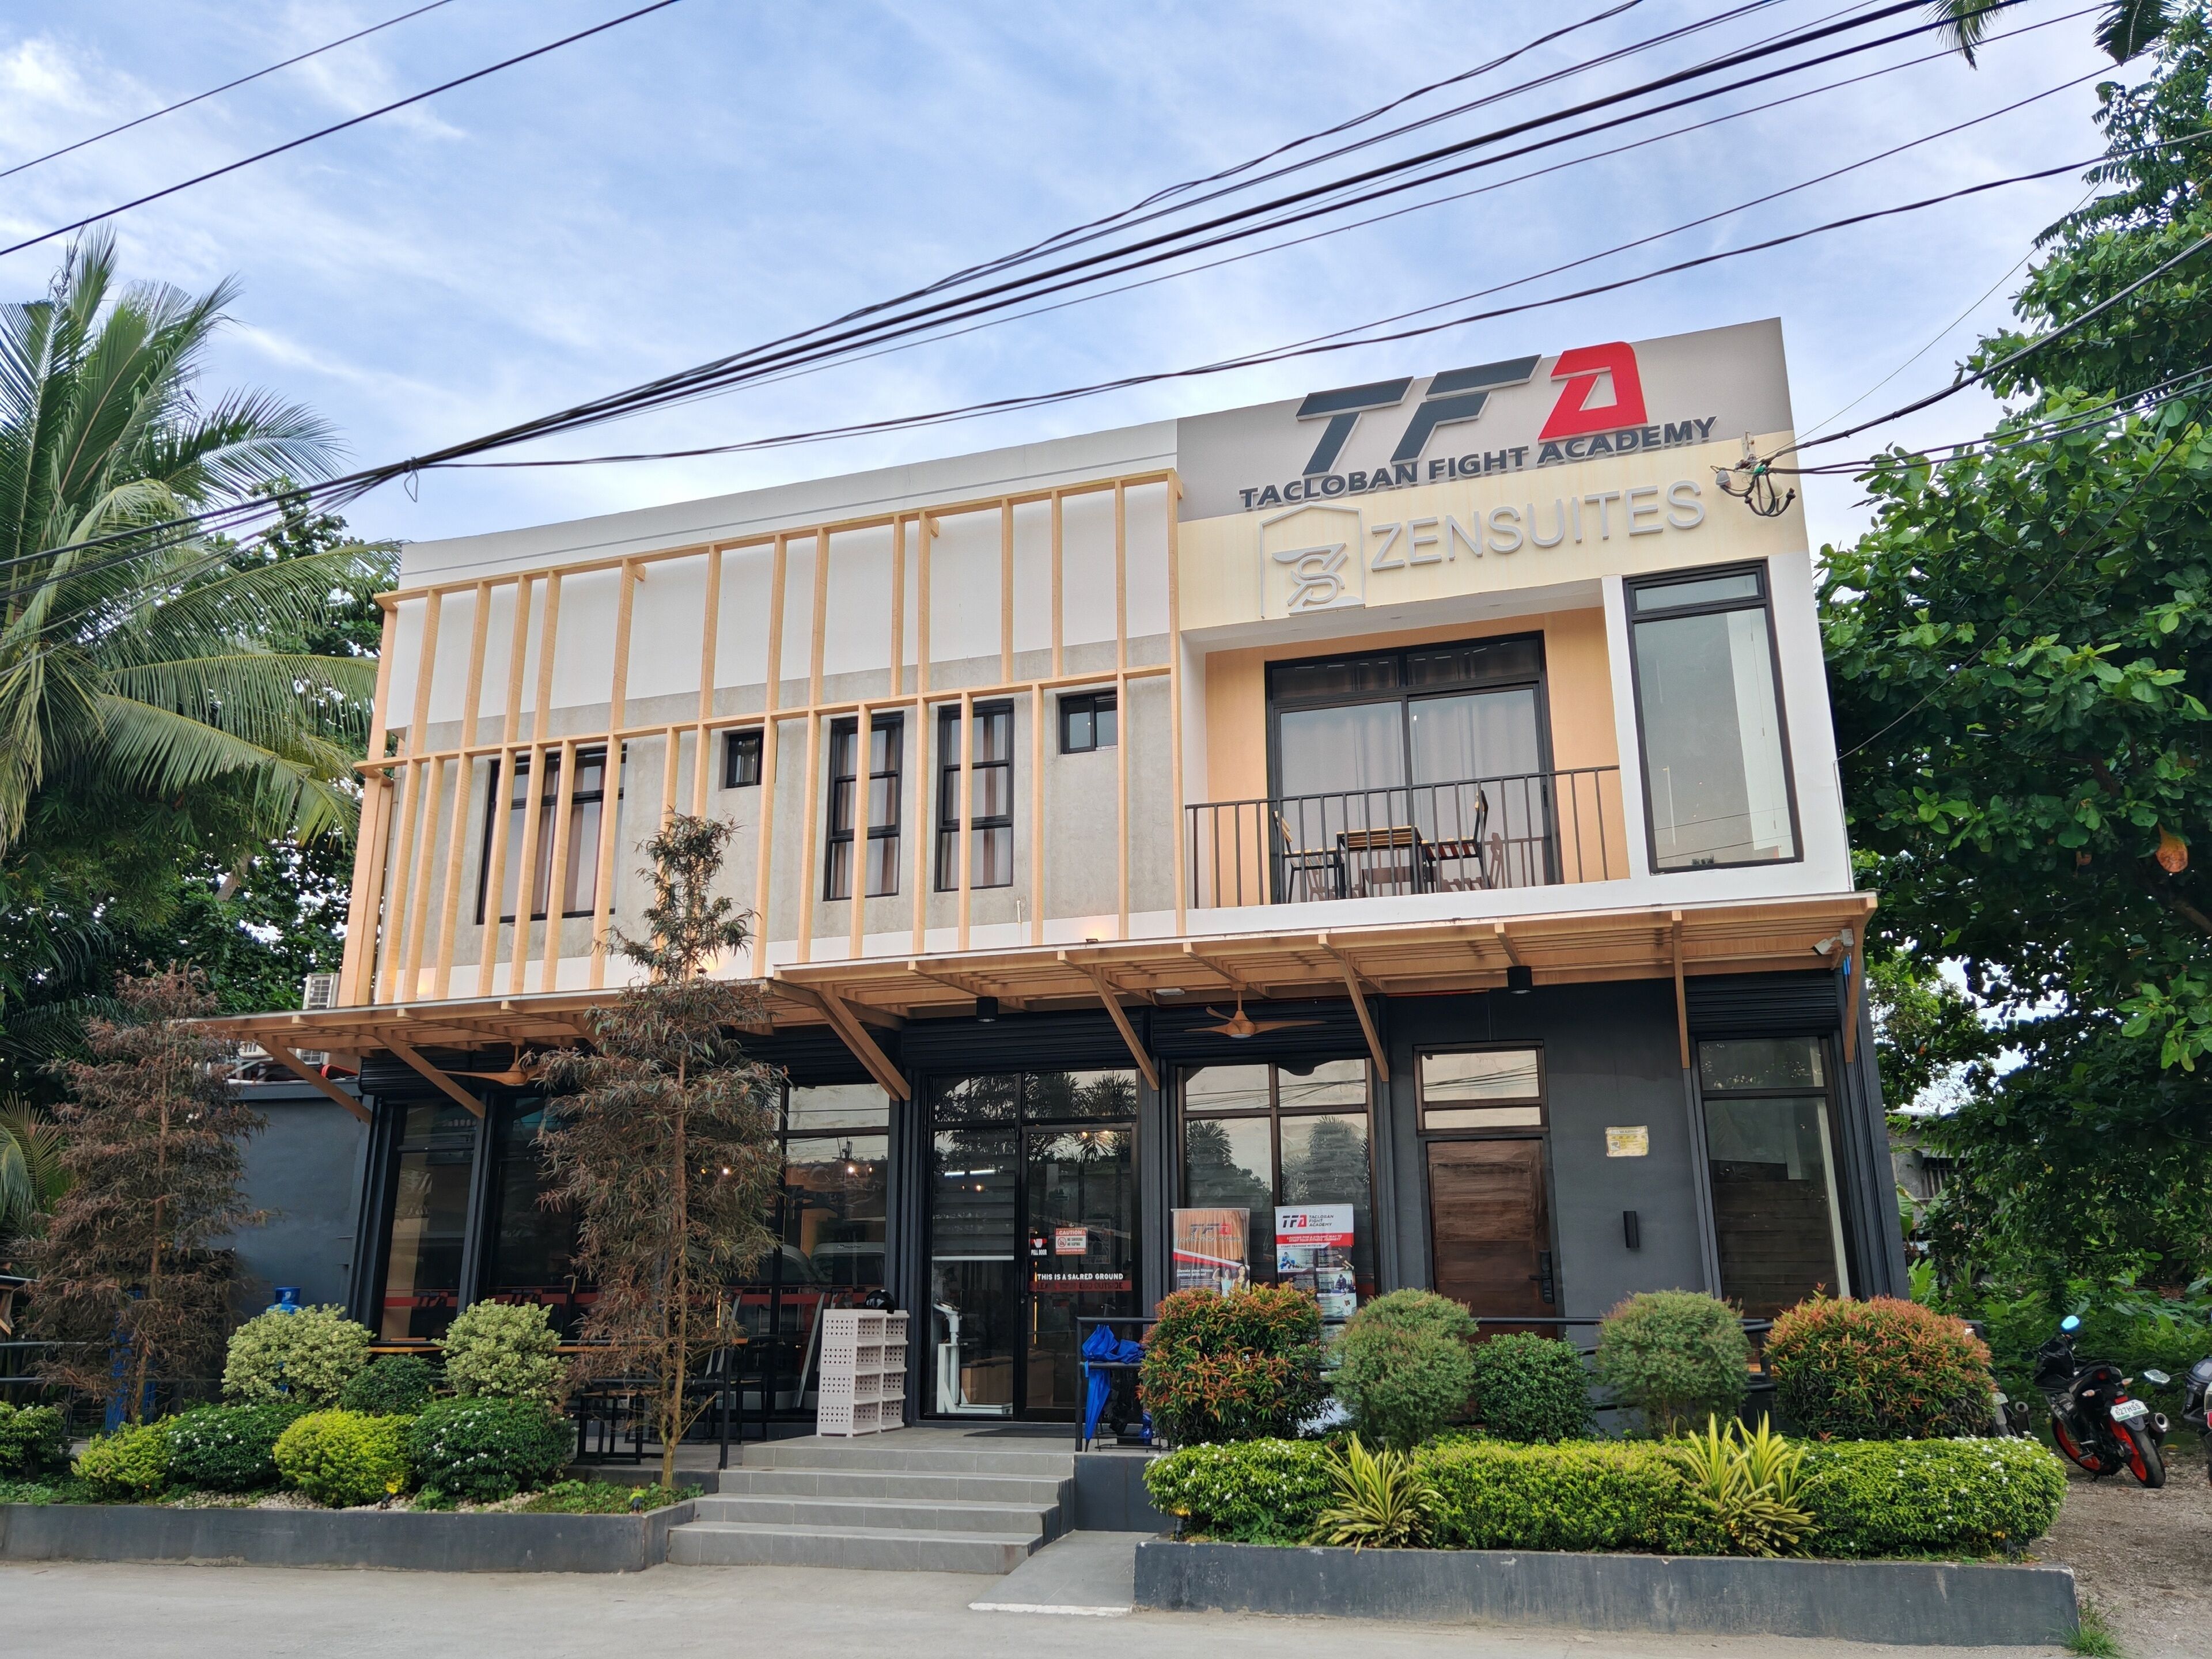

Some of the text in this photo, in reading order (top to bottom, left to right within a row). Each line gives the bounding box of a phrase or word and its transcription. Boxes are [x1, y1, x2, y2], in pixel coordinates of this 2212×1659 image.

[1296, 342, 1648, 478] TFA
[1239, 416, 1717, 510] TACLOBAN FIGHT ACADEMY
[1371, 480, 1705, 571] ZENSUITES
[1282, 1214, 1307, 1228] TFA
[2115, 1403, 2142, 1416] 627HSS
